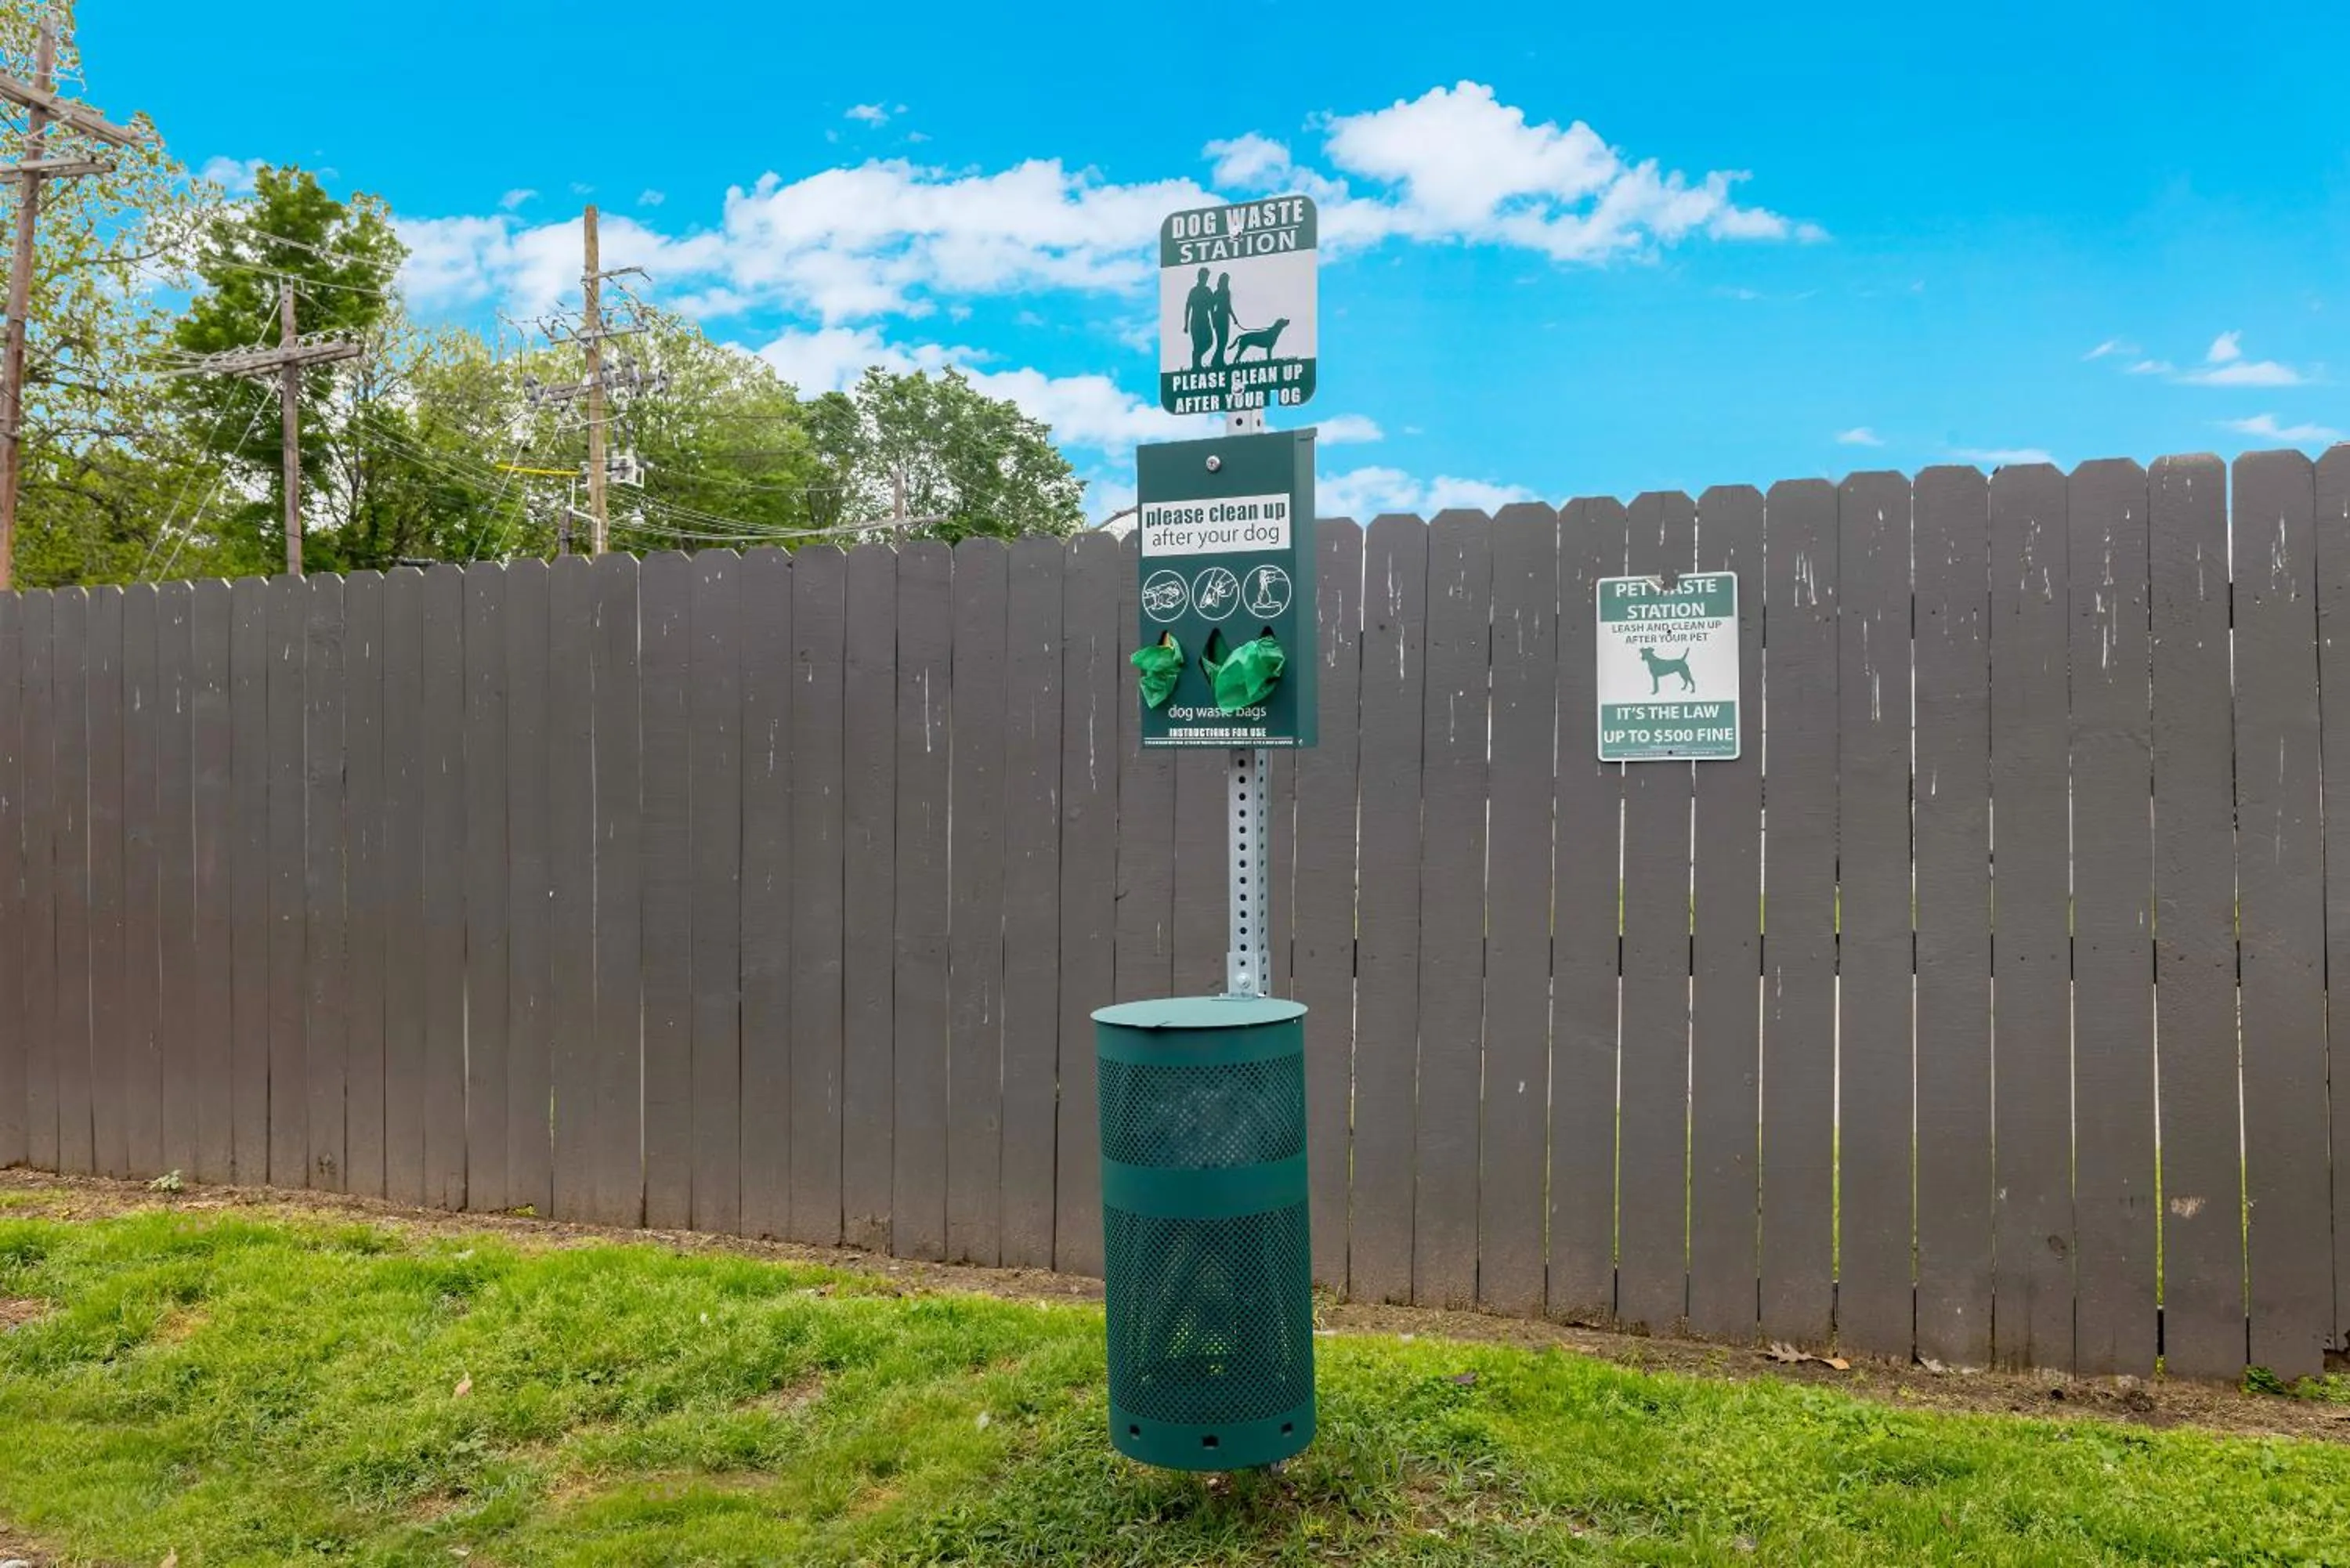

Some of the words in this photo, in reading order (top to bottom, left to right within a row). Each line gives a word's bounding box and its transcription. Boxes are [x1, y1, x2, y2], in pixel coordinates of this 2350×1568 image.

[1172, 211, 1217, 239] DOG
[1225, 199, 1303, 233] WASTE
[1180, 229, 1296, 264] STATION
[1172, 371, 1226, 391] PLEASE
[1231, 367, 1278, 385] CLEAN
[1282, 363, 1303, 381] UP
[1175, 394, 1220, 414] AFTER
[1224, 391, 1264, 409] YOUR
[1279, 388, 1301, 405] OG
[1146, 508, 1204, 528] please
[1209, 504, 1258, 522] clean
[1264, 502, 1285, 520] up
[1152, 528, 1192, 547] after
[1198, 529, 1239, 549] your
[1243, 523, 1280, 544] dog
[1615, 582, 1648, 597] PET
[1656, 579, 1718, 596] ASTE
[1627, 602, 1705, 620] STATION
[1611, 623, 1644, 634] LEASH
[1646, 623, 1669, 631] AND
[1671, 620, 1705, 630] CLEAN
[1707, 620, 1722, 629] UP
[1625, 634, 1657, 644] AFTER
[1658, 633, 1687, 643] YOUR
[1690, 632, 1708, 641] PET
[1168, 705, 1194, 721] dog
[1616, 707, 1645, 720] IT'S
[1648, 706, 1679, 720] THE
[1684, 705, 1719, 718] LAW
[1169, 728, 1230, 738] INSTRUCTIONS
[1231, 728, 1248, 737] FOR
[1249, 727, 1267, 737] USE
[1603, 730, 1625, 743] UP
[1628, 729, 1650, 742] TO
[1654, 728, 1694, 744] $500
[1697, 728, 1734, 742] FINE
